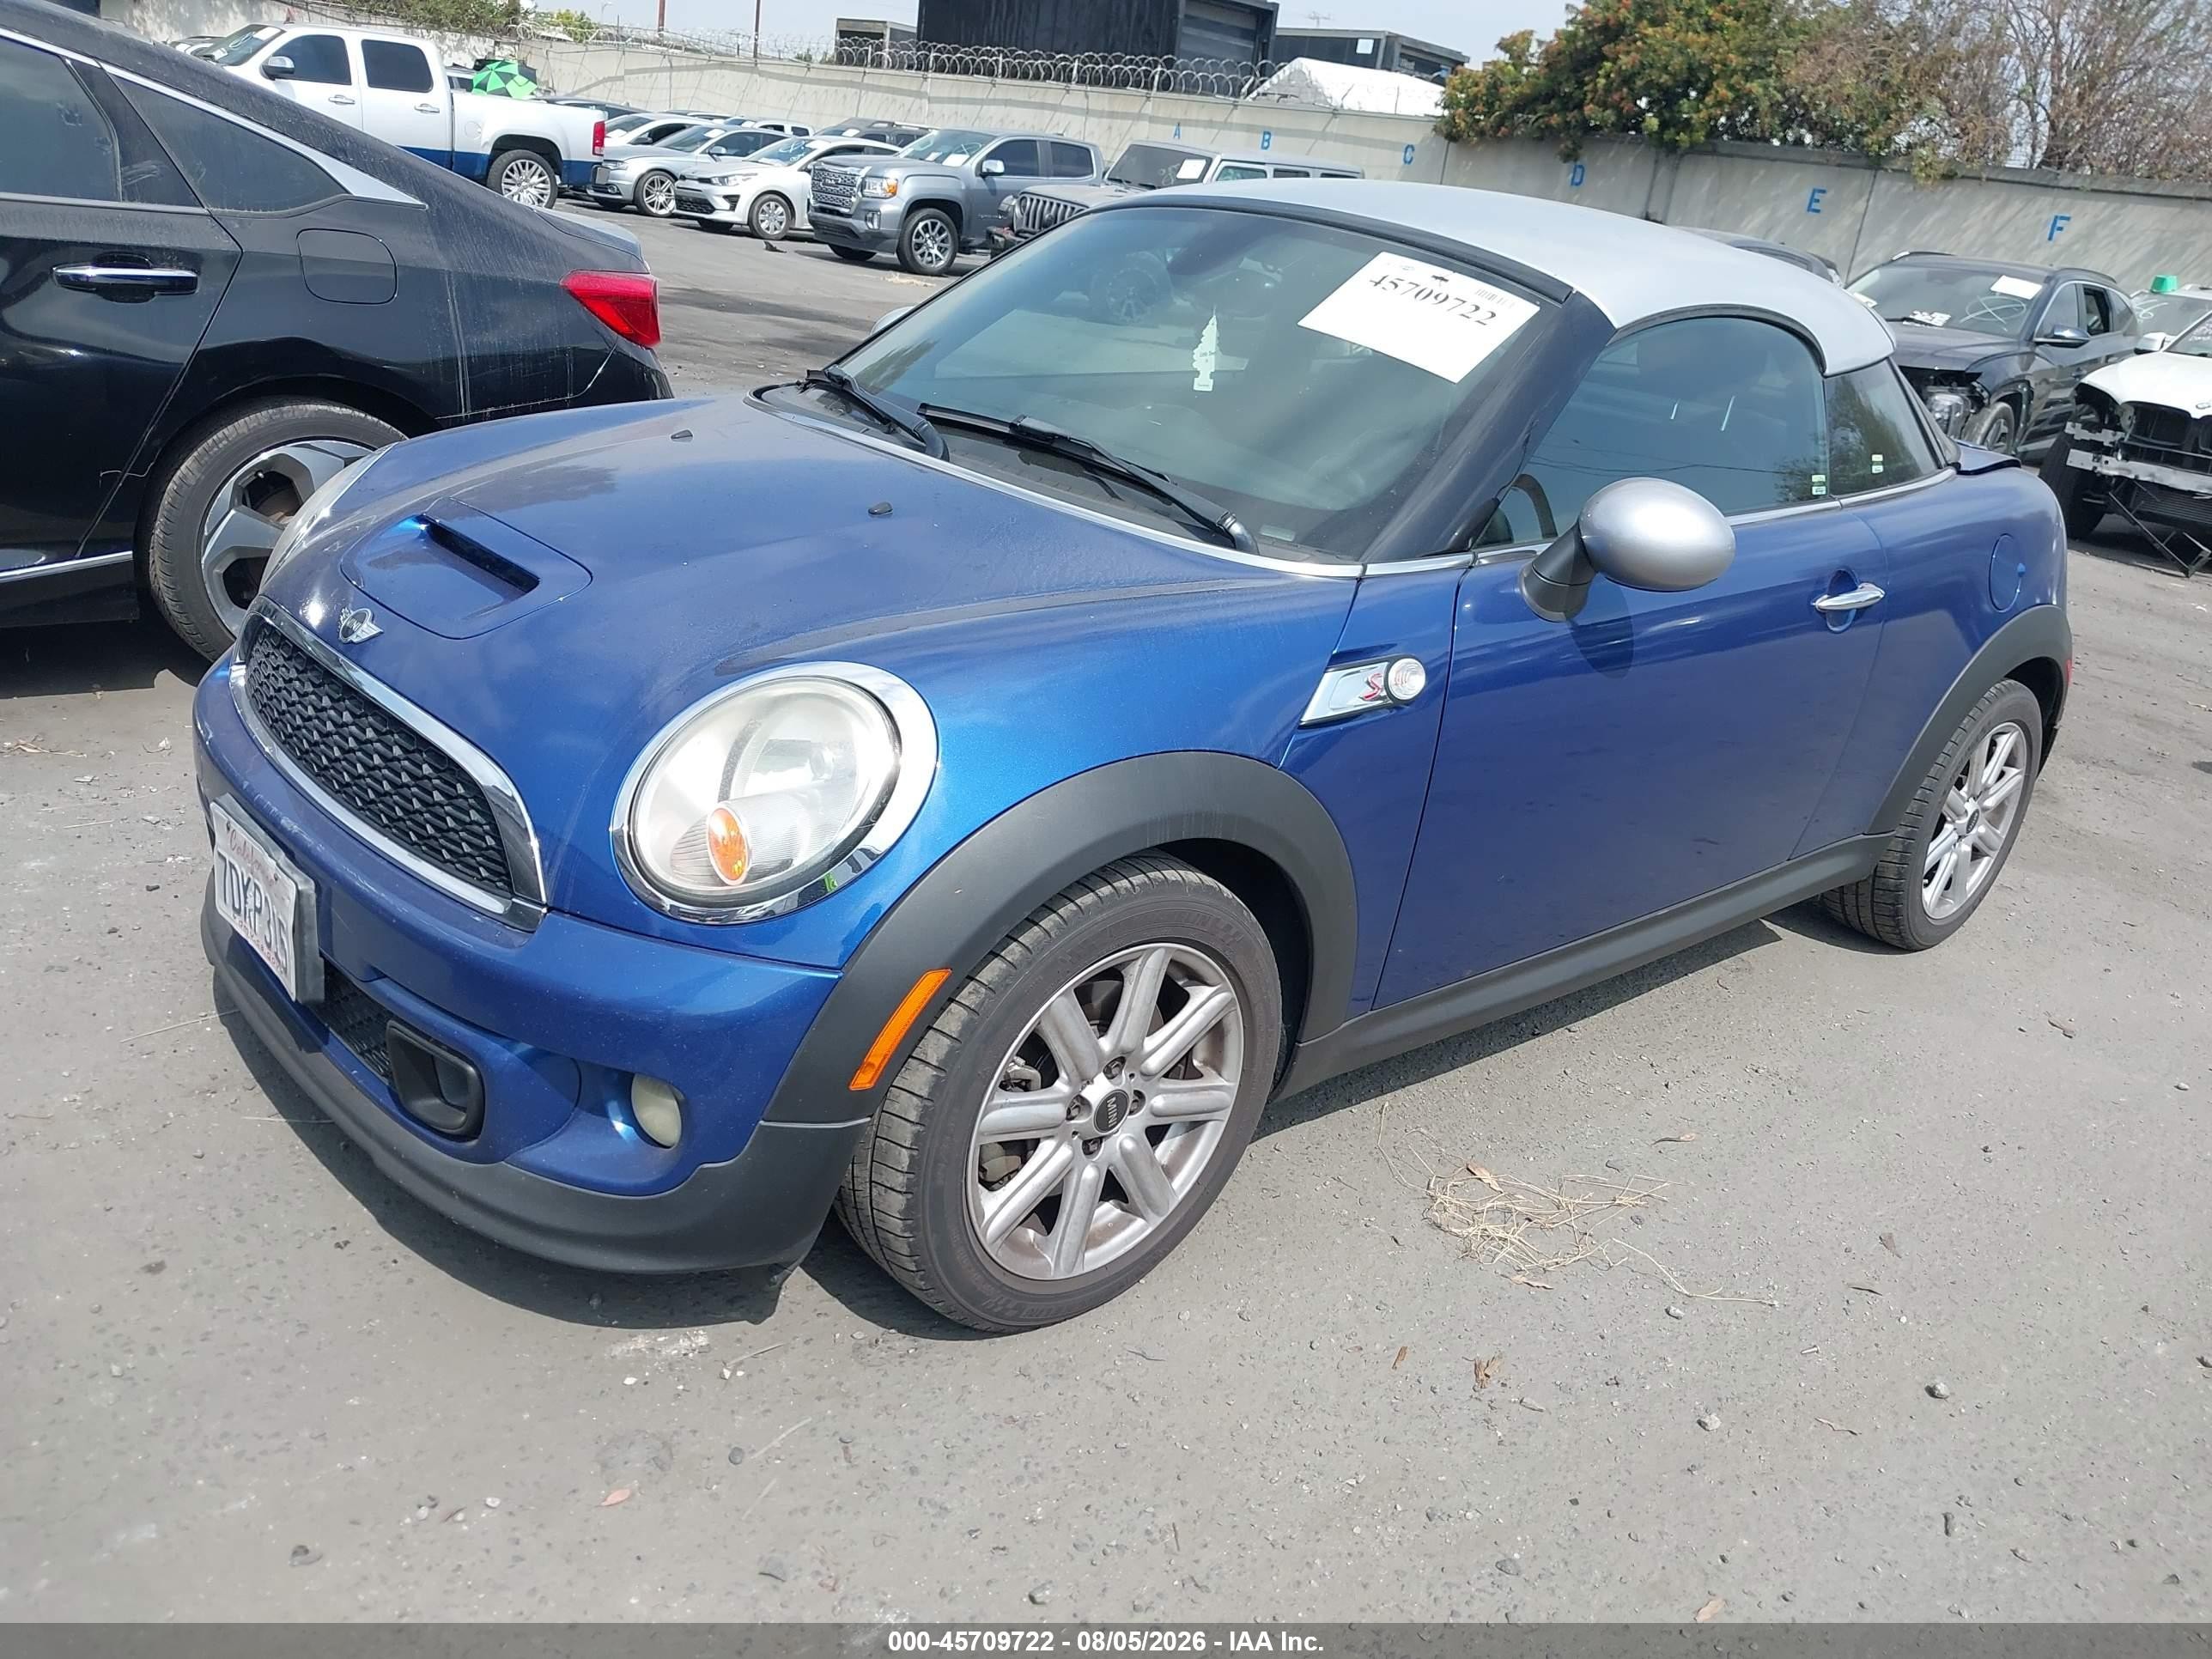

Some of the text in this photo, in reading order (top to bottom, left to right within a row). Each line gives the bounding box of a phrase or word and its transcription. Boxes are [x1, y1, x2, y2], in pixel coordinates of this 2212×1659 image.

[1173, 122, 1182, 139] A
[1261, 131, 1272, 150] B
[1403, 144, 1415, 165] C
[1571, 164, 1584, 186] D
[1807, 188, 1826, 213] E
[2047, 215, 2071, 241] F
[1369, 274, 1497, 325] 45709722
[1107, 1097, 1117, 1127] MINI
